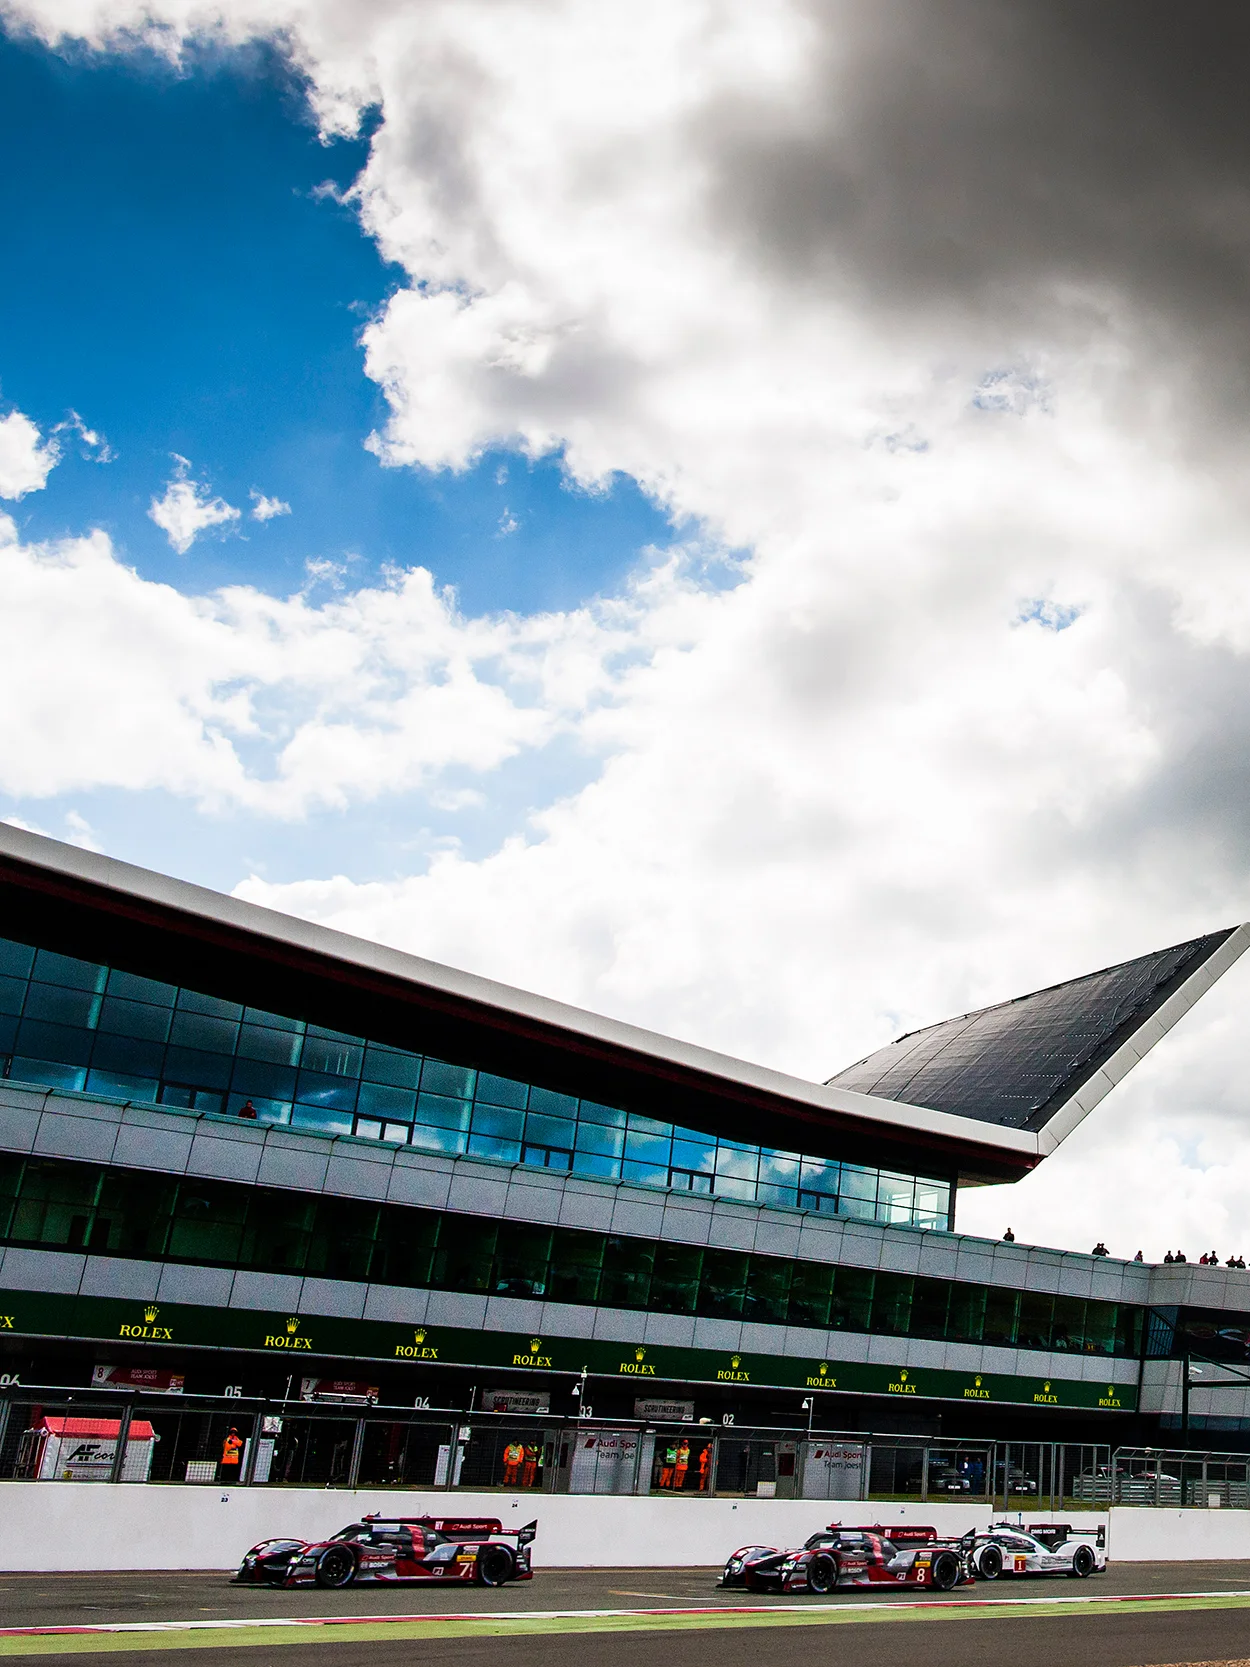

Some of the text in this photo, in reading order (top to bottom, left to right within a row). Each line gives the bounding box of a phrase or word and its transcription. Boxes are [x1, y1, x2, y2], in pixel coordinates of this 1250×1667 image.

[119, 1325, 173, 1340] ROLEX
[264, 1336, 312, 1349] ROLEX
[395, 1346, 438, 1358] ROLEX
[512, 1355, 552, 1367] ROLEX
[619, 1363, 656, 1375] ROLEX
[717, 1371, 750, 1381] ROLEX
[806, 1377, 837, 1388] ROLEX
[888, 1383, 916, 1393] ROLEX
[224, 1385, 243, 1398] 05
[964, 1389, 990, 1398] ROLEX
[414, 1396, 430, 1408] 04
[1034, 1394, 1058, 1403] ROLEX
[1098, 1398, 1121, 1407] ROLEX
[722, 1413, 735, 1425] 02
[597, 1439, 618, 1448] Audi
[459, 1562, 471, 1576] 7
[1017, 1560, 1022, 1570] 1
[916, 1568, 926, 1582] 8
